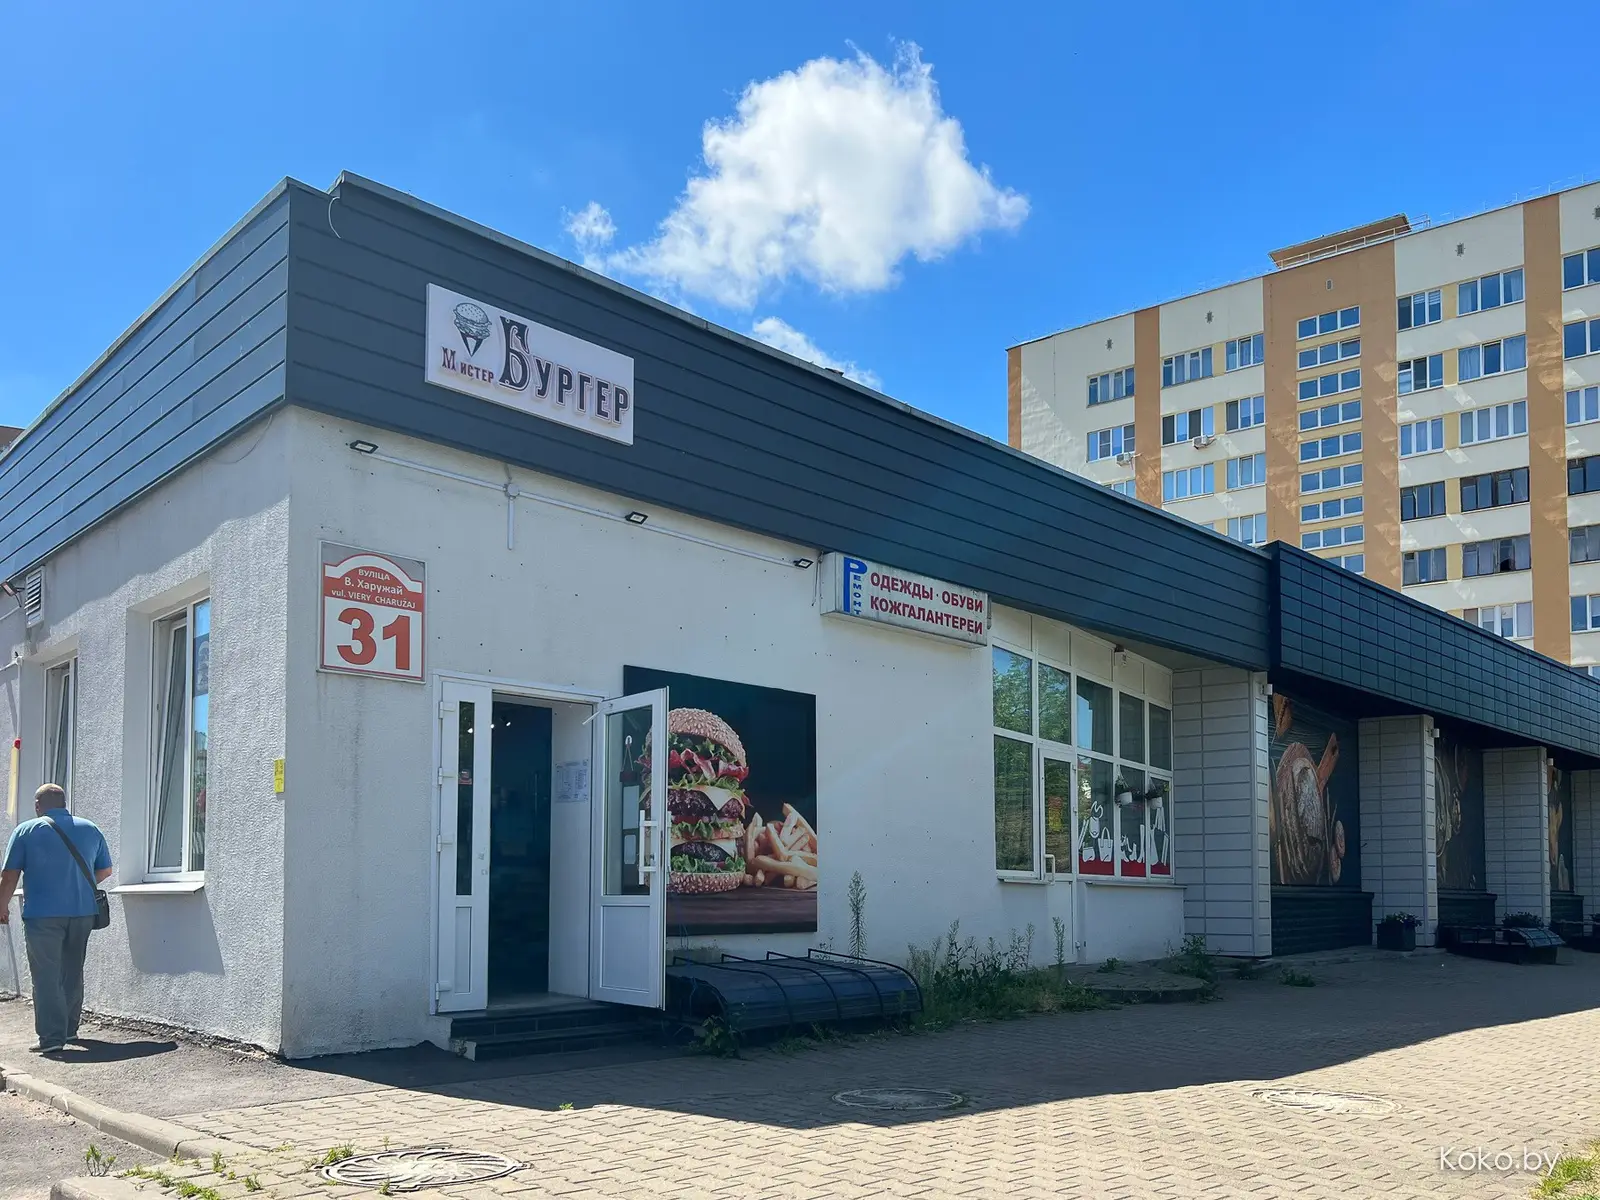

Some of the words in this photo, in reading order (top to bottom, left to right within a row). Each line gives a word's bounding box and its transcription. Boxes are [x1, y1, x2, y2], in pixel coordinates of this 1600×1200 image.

[499, 315, 631, 425] БУРГЕР
[331, 589, 346, 598] vul.
[348, 591, 371, 601] VIERY
[344, 576, 355, 587] В.
[357, 578, 403, 595] Харужай
[870, 572, 934, 601] ОДЕЖДЫ
[941, 590, 983, 613] ОБУВИ
[870, 595, 983, 635] КОЖГАЛАНТЕРЕИ
[337, 607, 410, 671] 31
